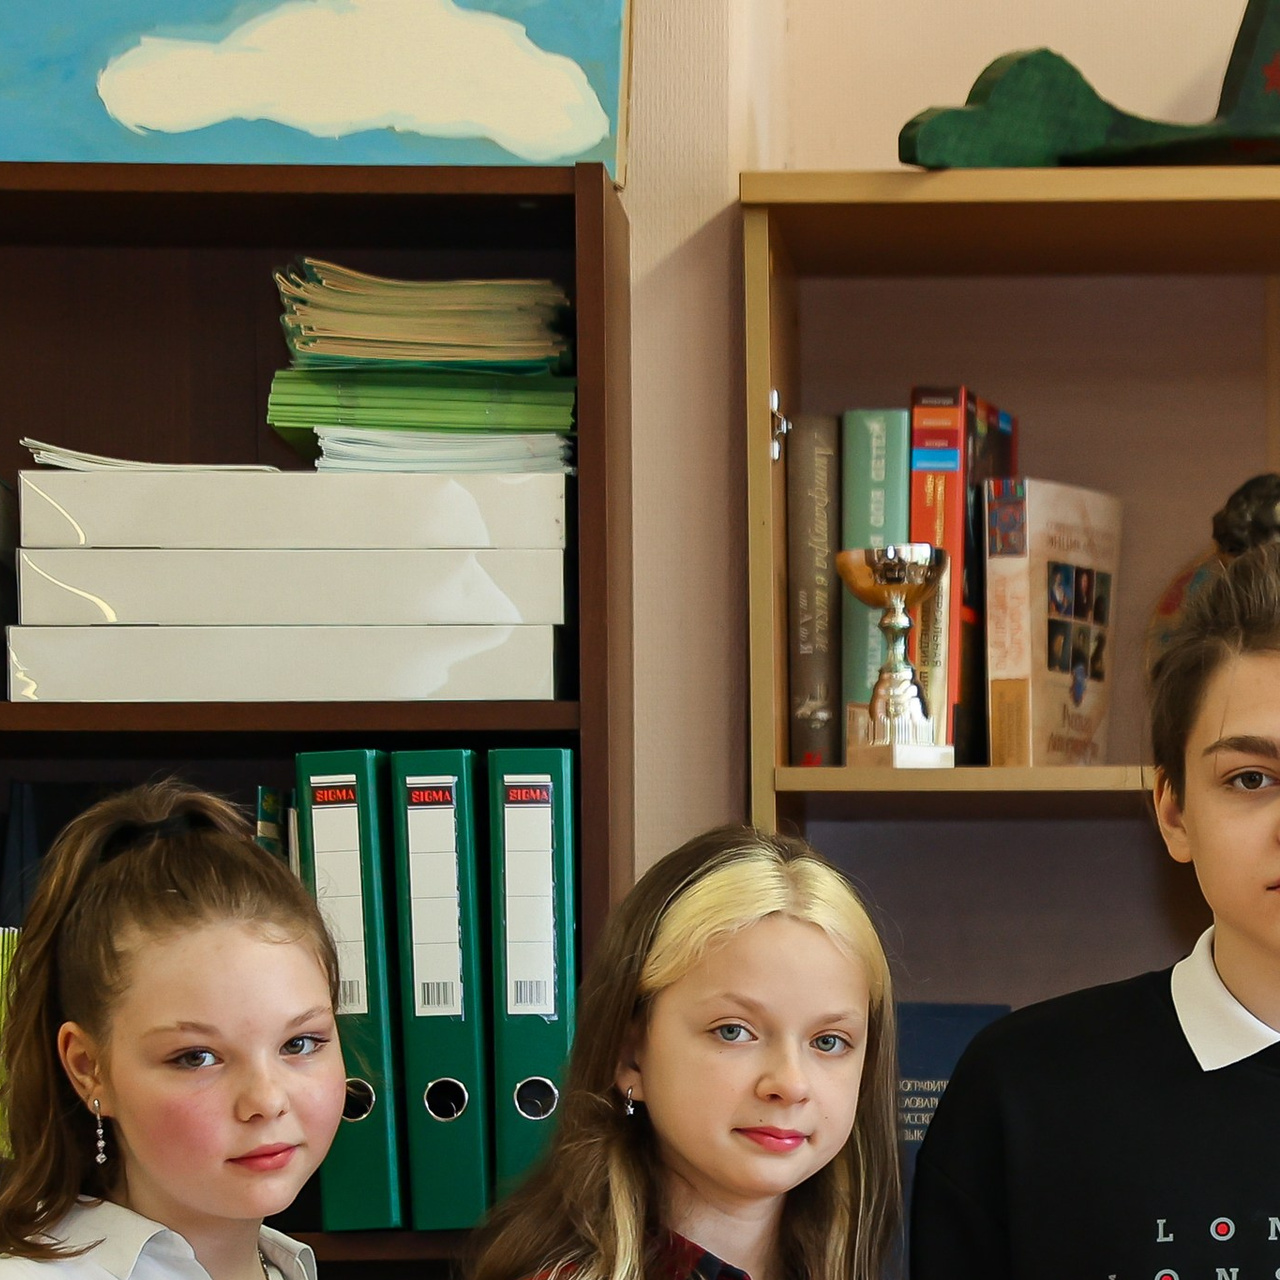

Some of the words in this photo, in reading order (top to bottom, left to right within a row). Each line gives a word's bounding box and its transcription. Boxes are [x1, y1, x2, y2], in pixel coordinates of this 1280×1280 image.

[815, 574, 829, 586] в
[799, 642, 813, 654] Я
[316, 788, 356, 802] SIGMA
[411, 789, 451, 803] SIGMA
[508, 789, 548, 802] SIGMA
